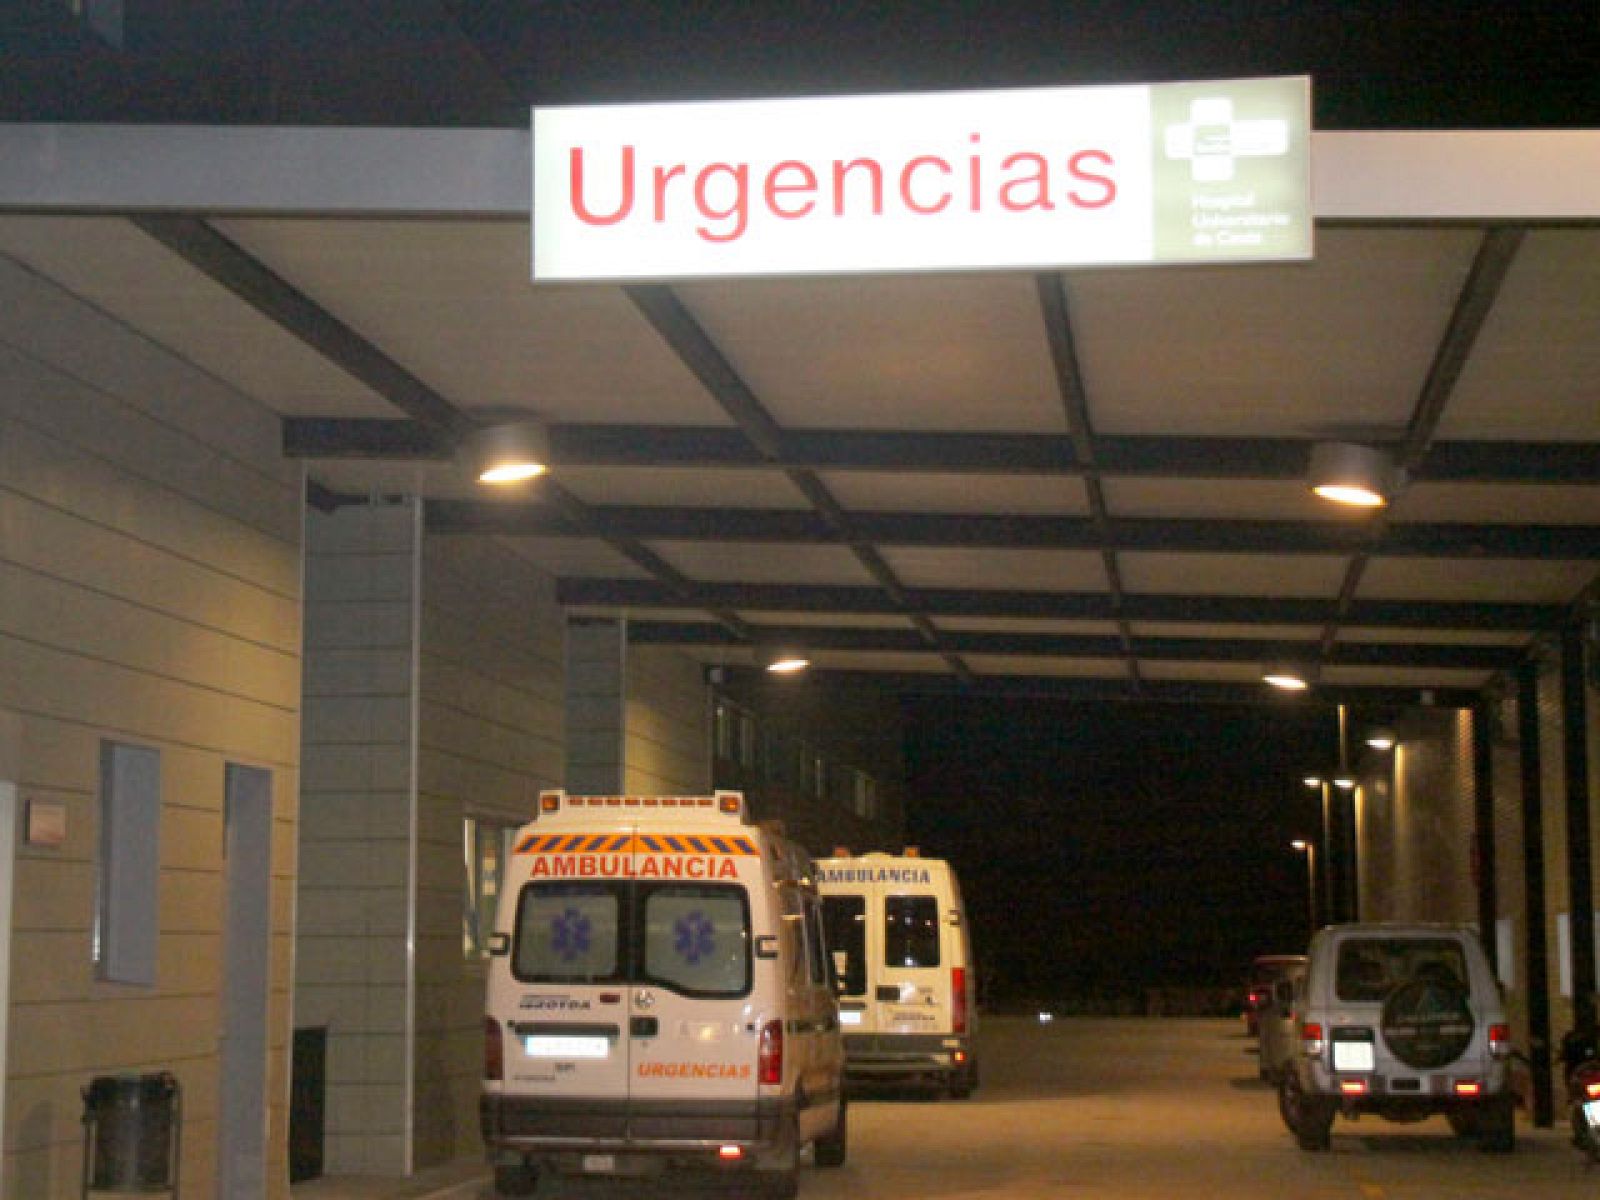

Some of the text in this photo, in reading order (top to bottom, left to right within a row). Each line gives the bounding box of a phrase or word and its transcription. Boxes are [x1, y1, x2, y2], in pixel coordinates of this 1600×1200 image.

[569, 132, 1117, 243] Urgencias
[531, 855, 738, 879] AMBULANCIA
[816, 868, 931, 883] AMBULANCIA
[637, 1062, 751, 1079] URGENCIAS
